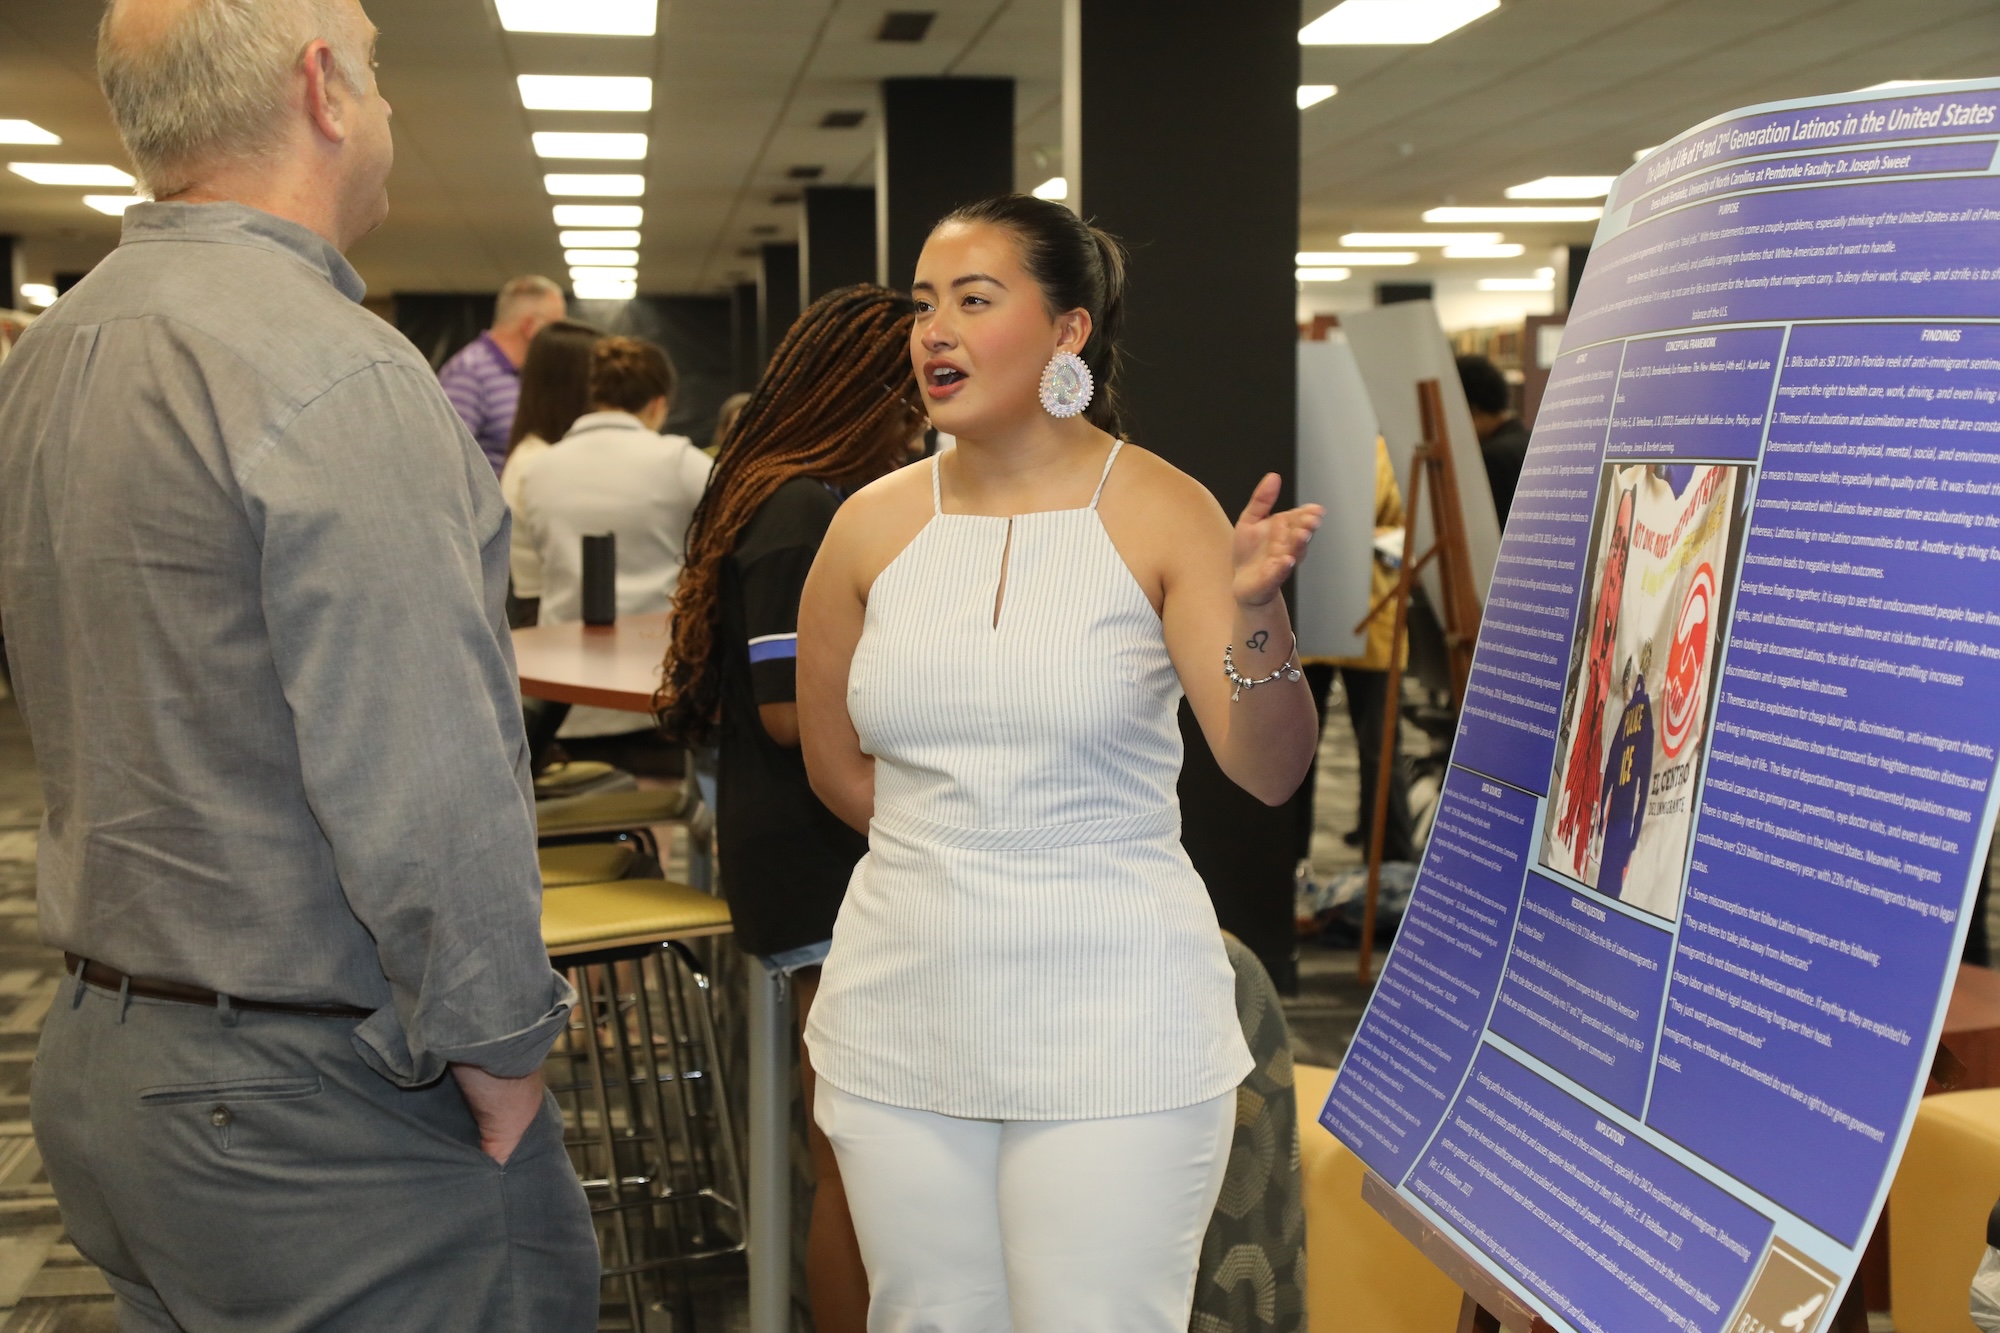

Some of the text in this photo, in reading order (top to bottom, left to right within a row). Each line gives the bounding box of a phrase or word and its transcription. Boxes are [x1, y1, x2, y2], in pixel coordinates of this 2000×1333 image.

[1687, 142, 1697, 164] of
[1702, 134, 1718, 158] and
[1730, 121, 1790, 150] Generation
[1792, 116, 1841, 141] Latinos
[1842, 113, 1857, 135] in
[1859, 110, 1885, 133] the
[1888, 104, 1943, 130] United
[1942, 103, 1996, 126] States
[1688, 180, 1709, 197] University
[1715, 173, 1730, 189] North
[1730, 169, 1756, 186] Carolina
[1756, 169, 1765, 182] at
[1764, 162, 1803, 180] Pembroke
[1803, 160, 1836, 177] Faculty:
[1836, 160, 1848, 174] Dr.
[1849, 156, 1881, 173] Joseph
[1882, 155, 1912, 170] Sweet
[1718, 202, 1740, 215] PURPOSE
[1744, 225, 1760, 235] come
[1759, 224, 1765, 233] a
[1764, 220, 1785, 234] couple
[1783, 218, 1814, 233] problems,
[1815, 215, 1848, 230] especially
[1847, 214, 1877, 228] thinking
[1875, 212, 1887, 225] of
[1884, 212, 1899, 224] the
[1898, 210, 1926, 224] United
[1923, 210, 1950, 223] States
[1948, 212, 1960, 222] as
[1959, 208, 1973, 221] all
[1970, 207, 1984, 221] of
[1739, 240, 1896, 262] burdens that White Americans don't want to handle.
[1743, 267, 1991, 288] humanity that immigrants carry. To deny their work, struggle, and strife is to
[1690, 337, 1717, 350] FRAMEWORK
[1921, 329, 1962, 342] FINDINGS
[1790, 355, 1804, 368] Bills
[1803, 355, 1819, 367] such
[1817, 358, 1827, 367] as
[1825, 355, 1837, 367] SB
[1835, 355, 1854, 367] 1718
[1852, 355, 1861, 367] in
[1860, 355, 1886, 367] Florida
[1885, 355, 1903, 368] reek
[1901, 354, 1913, 368] of
[1910, 356, 1970, 371] anti-immigrant
[1744, 551, 1884, 579] discrimination leads to negative health outcomes.
[1742, 637, 1763, 655] looking
[1761, 642, 1770, 653] at
[1768, 642, 1804, 659] documented
[1802, 648, 1825, 664] Latinos,
[1823, 651, 1838, 665] the
[1837, 653, 1850, 666] risk
[1849, 655, 1859, 668] of
[1857, 658, 1899, 675] racial/ethnic
[1896, 664, 1929, 683] profiling
[1928, 671, 1964, 686] increases
[1622, 703, 1645, 742] POLICE
[1726, 692, 1747, 708] Themes
[1745, 698, 1760, 710] such
[1758, 701, 1767, 712] as
[1765, 702, 1800, 718] exploitation
[1798, 706, 1809, 720] for
[1807, 709, 1827, 726] cheap
[1826, 712, 1844, 727] labor
[1841, 717, 1857, 733] jobs,
[1855, 719, 1905, 742] discrimination,
[1903, 732, 1961, 752] anti-immigrant
[1960, 740, 1994, 762] rhetoric,
[1619, 745, 1635, 786] ICE
[1661, 762, 1690, 792] CENTRO
[1692, 887, 1709, 903] Some
[1707, 895, 1749, 917] misconceptions
[1748, 907, 1761, 922] that
[1760, 910, 1779, 928] follow
[1777, 917, 1797, 935] Latino
[1795, 926, 1829, 946] immigrants
[1827, 938, 1840, 950] are
[1839, 939, 1851, 954] the
[1697, 921, 1708, 933] are
[1707, 922, 1721, 937] here
[1719, 928, 1727, 940] to
[1726, 930, 1739, 945] take
[1737, 935, 1751, 949] jobs
[1749, 941, 1766, 957] away
[1765, 943, 1780, 960] from
[1682, 1005, 1695, 1018] just
[1693, 1010, 1708, 1024] want
[1705, 1015, 1739, 1037] government
[1596, 1120, 1626, 1146] IMPLICATIONS
